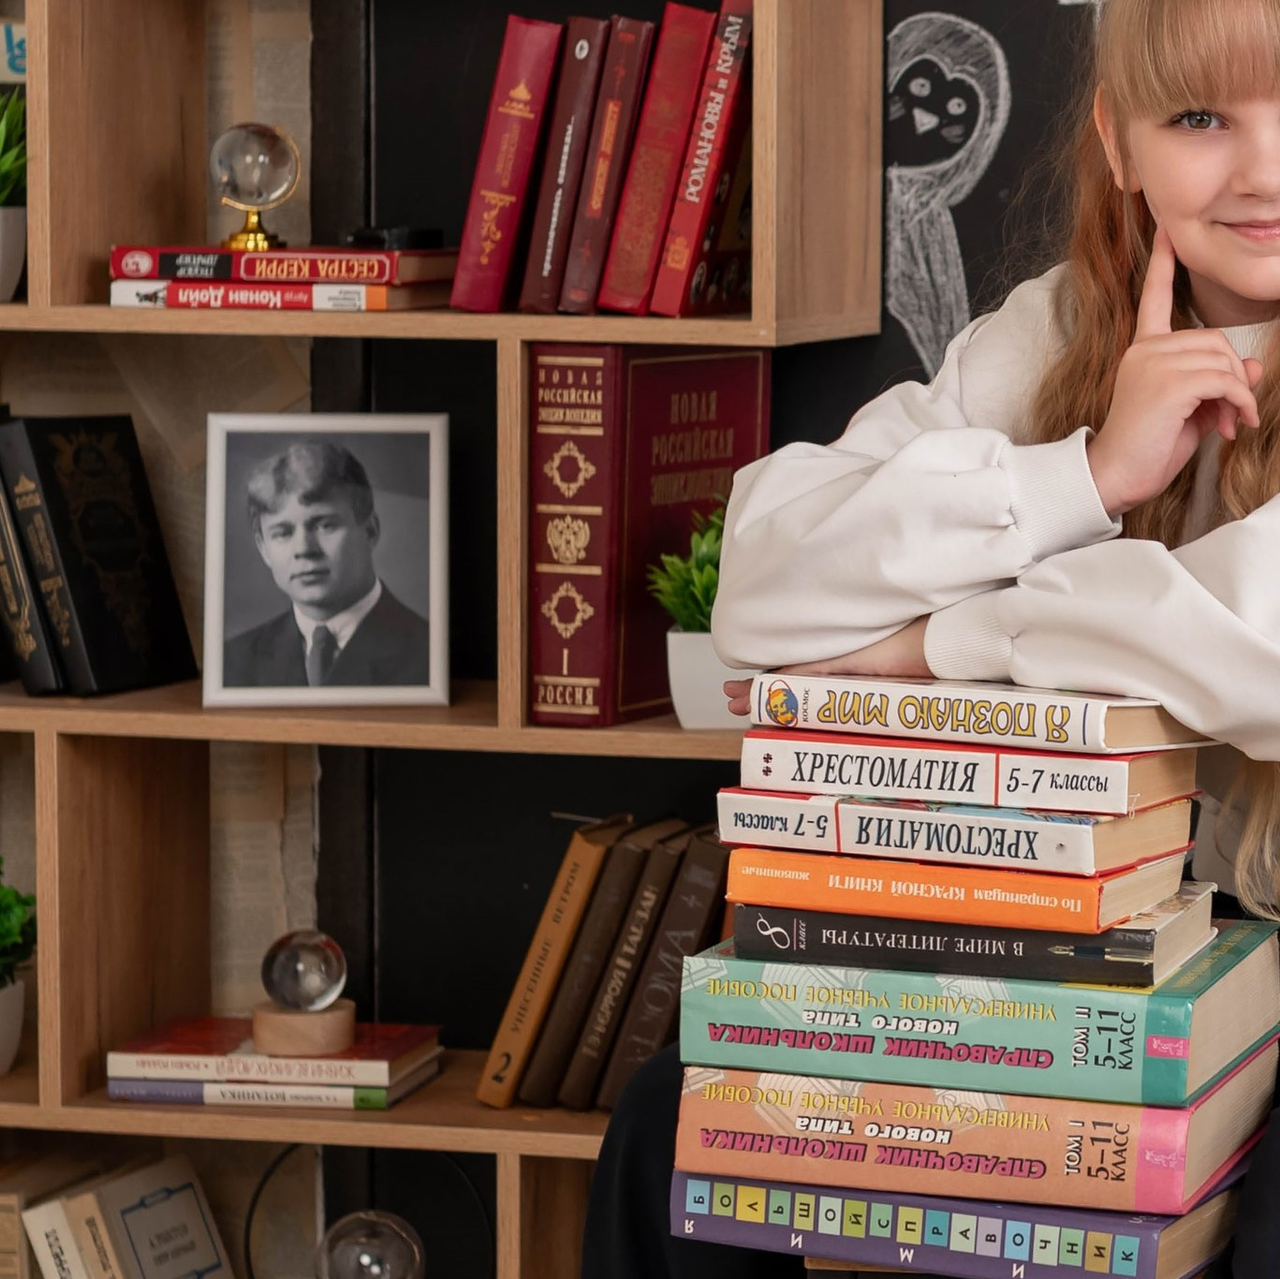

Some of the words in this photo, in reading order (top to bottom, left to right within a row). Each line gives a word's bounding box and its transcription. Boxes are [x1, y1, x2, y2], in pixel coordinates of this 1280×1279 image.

[684, 92, 726, 203] РОМАНОВЫ
[714, 16, 743, 75] КРЫМ
[255, 259, 309, 279] КЕРРИ
[317, 259, 379, 279] СЕСТРА
[178, 287, 225, 309] Дойл
[229, 289, 282, 309] Конан
[538, 385, 603, 405] РОССИЙСКАЯ
[669, 389, 718, 425] НОВАЯ
[651, 427, 734, 466] РОССИЙСКАЯ
[537, 684, 595, 706] РОССИЯ
[801, 687, 812, 724] КОСМОС
[817, 690, 889, 729] МИР
[897, 696, 1037, 739] ПОЗНАЮ
[1045, 705, 1071, 744] Я
[791, 751, 980, 793] ХРЕСТОМАТИЯ
[1006, 766, 1045, 793] 5-7
[1049, 772, 1109, 793] классы
[733, 812, 789, 833] классы
[793, 813, 829, 839] 5-7
[855, 816, 1039, 861] ХРЕСТОМАТИЯ
[741, 865, 811, 883] животные
[828, 874, 883, 894] КНИГИ
[891, 879, 966, 903] КРАСНОЙ
[973, 887, 1059, 910] страницам
[1060, 897, 1082, 914] По
[756, 913, 791, 950] 8
[798, 919, 809, 951] класс
[821, 929, 948, 953] ЛИТЕРАТУРЫ
[509, 938, 552, 1035] УНЕСЕННЫЕ
[551, 861, 581, 926] ВЕТРОМ
[954, 937, 1006, 956] МИРЕ
[1013, 941, 1024, 957] В
[705, 979, 797, 1003] ПОСОБИЕ
[805, 986, 891, 1011] УЧЕБНОЕ
[897, 992, 1058, 1023] УНИВЕРСАЛЬНОЕ
[801, 1010, 862, 1032] типа
[870, 1013, 958, 1038] нового
[706, 1022, 874, 1055] ШКОЛЬНИКА
[1072, 1027, 1089, 1068] ТОМ
[1117, 1011, 1136, 1071] КЛАСС
[882, 1035, 1054, 1070] СПРАВОЧНИК
[490, 1052, 513, 1085] 2
[700, 1083, 792, 1106] ПОСОБИЕ
[801, 1092, 884, 1117] УЧЕБНОЕ
[794, 1116, 853, 1138] типа
[893, 1102, 1050, 1132] УНИВЕРСАЛЬНОЕ
[700, 1129, 867, 1164] ШКОЛЬНИКА
[864, 1123, 952, 1146] нового
[877, 1145, 1047, 1179] СПРАВОЧНИК
[1064, 1135, 1083, 1176] ТОМ
[1110, 1121, 1130, 1183] КЛАСС
